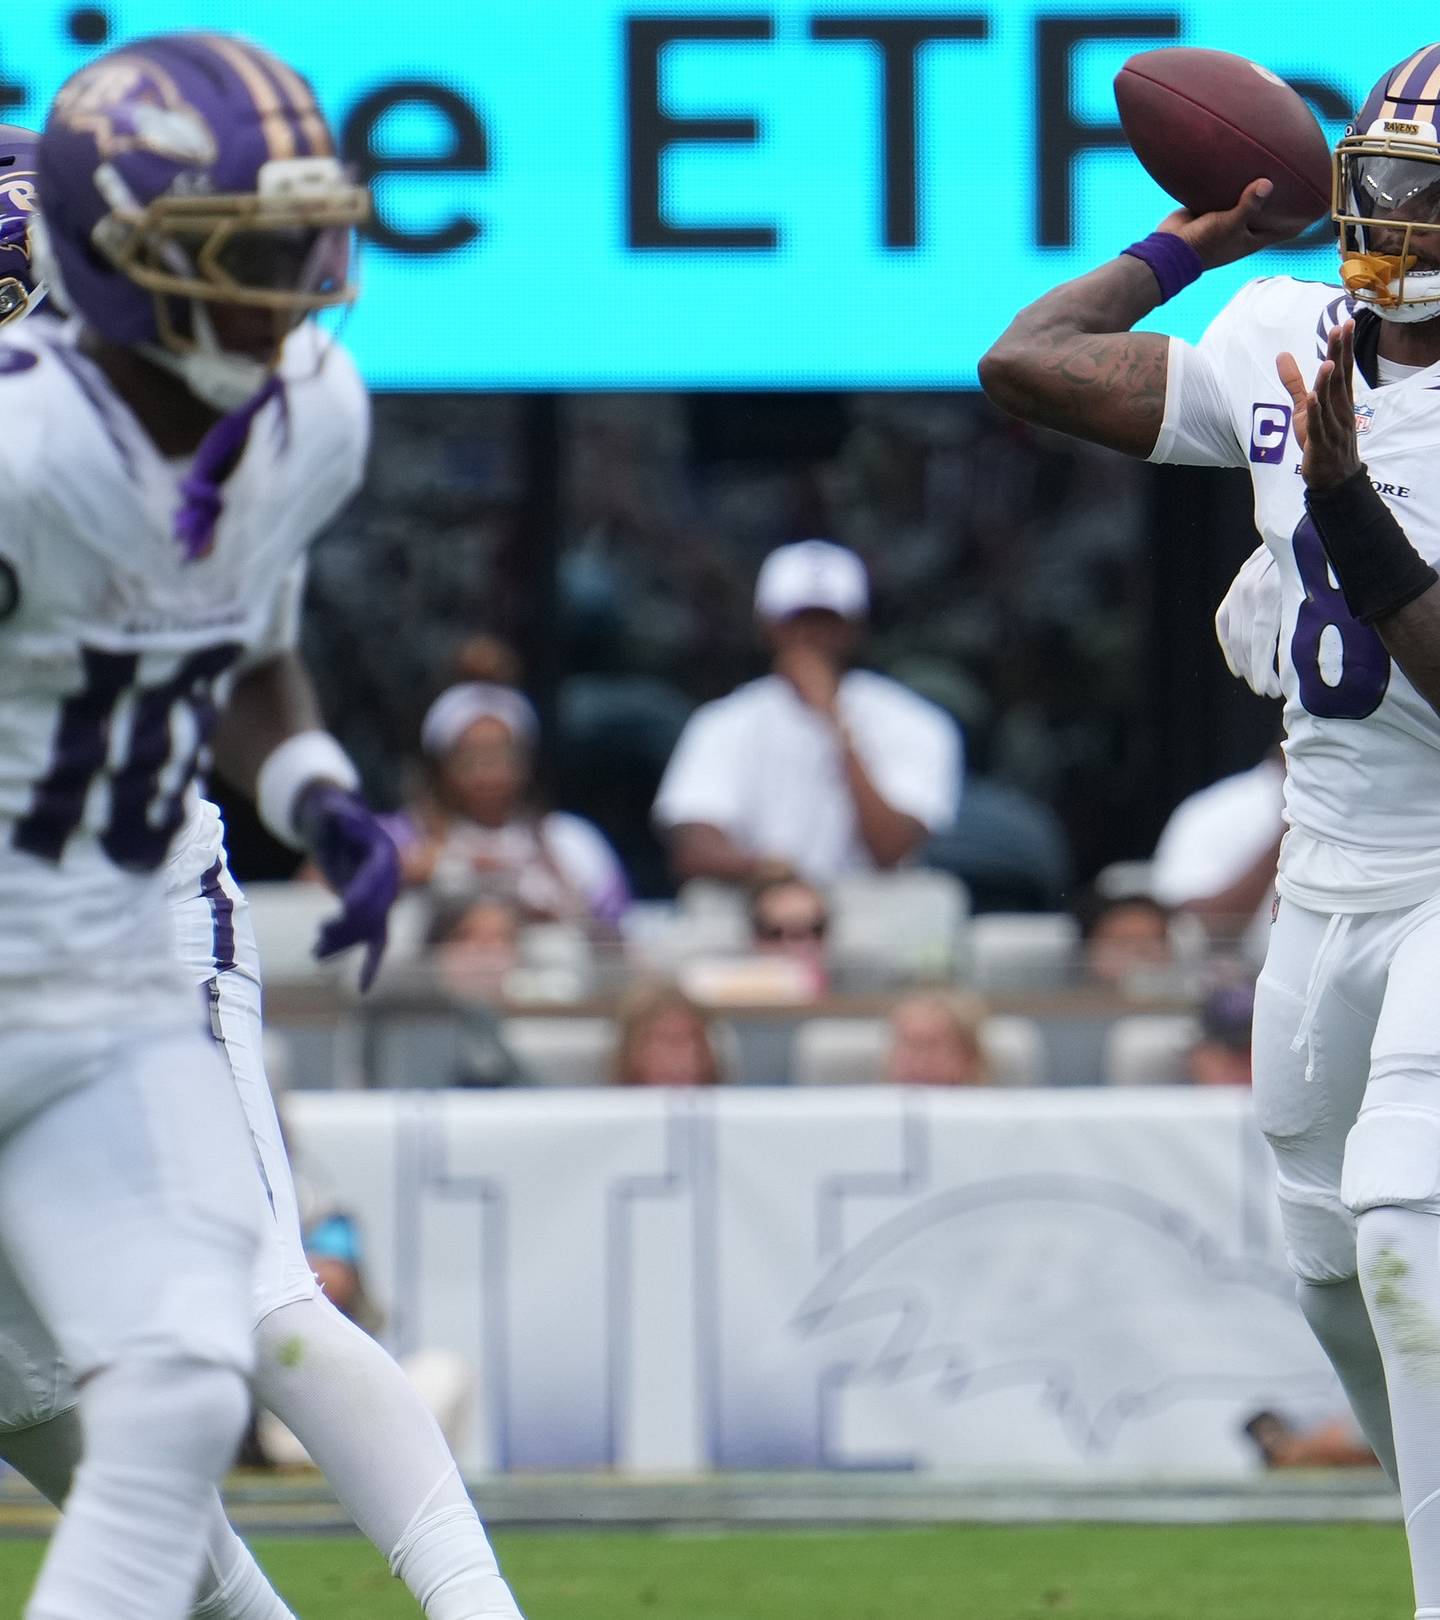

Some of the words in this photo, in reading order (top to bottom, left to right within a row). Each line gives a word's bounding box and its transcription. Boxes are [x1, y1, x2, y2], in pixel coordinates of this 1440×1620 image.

[1384, 121, 1419, 135] RAVENS
[1253, 407, 1287, 449] C
[1291, 510, 1391, 720] 8
[12, 640, 244, 874] 10
